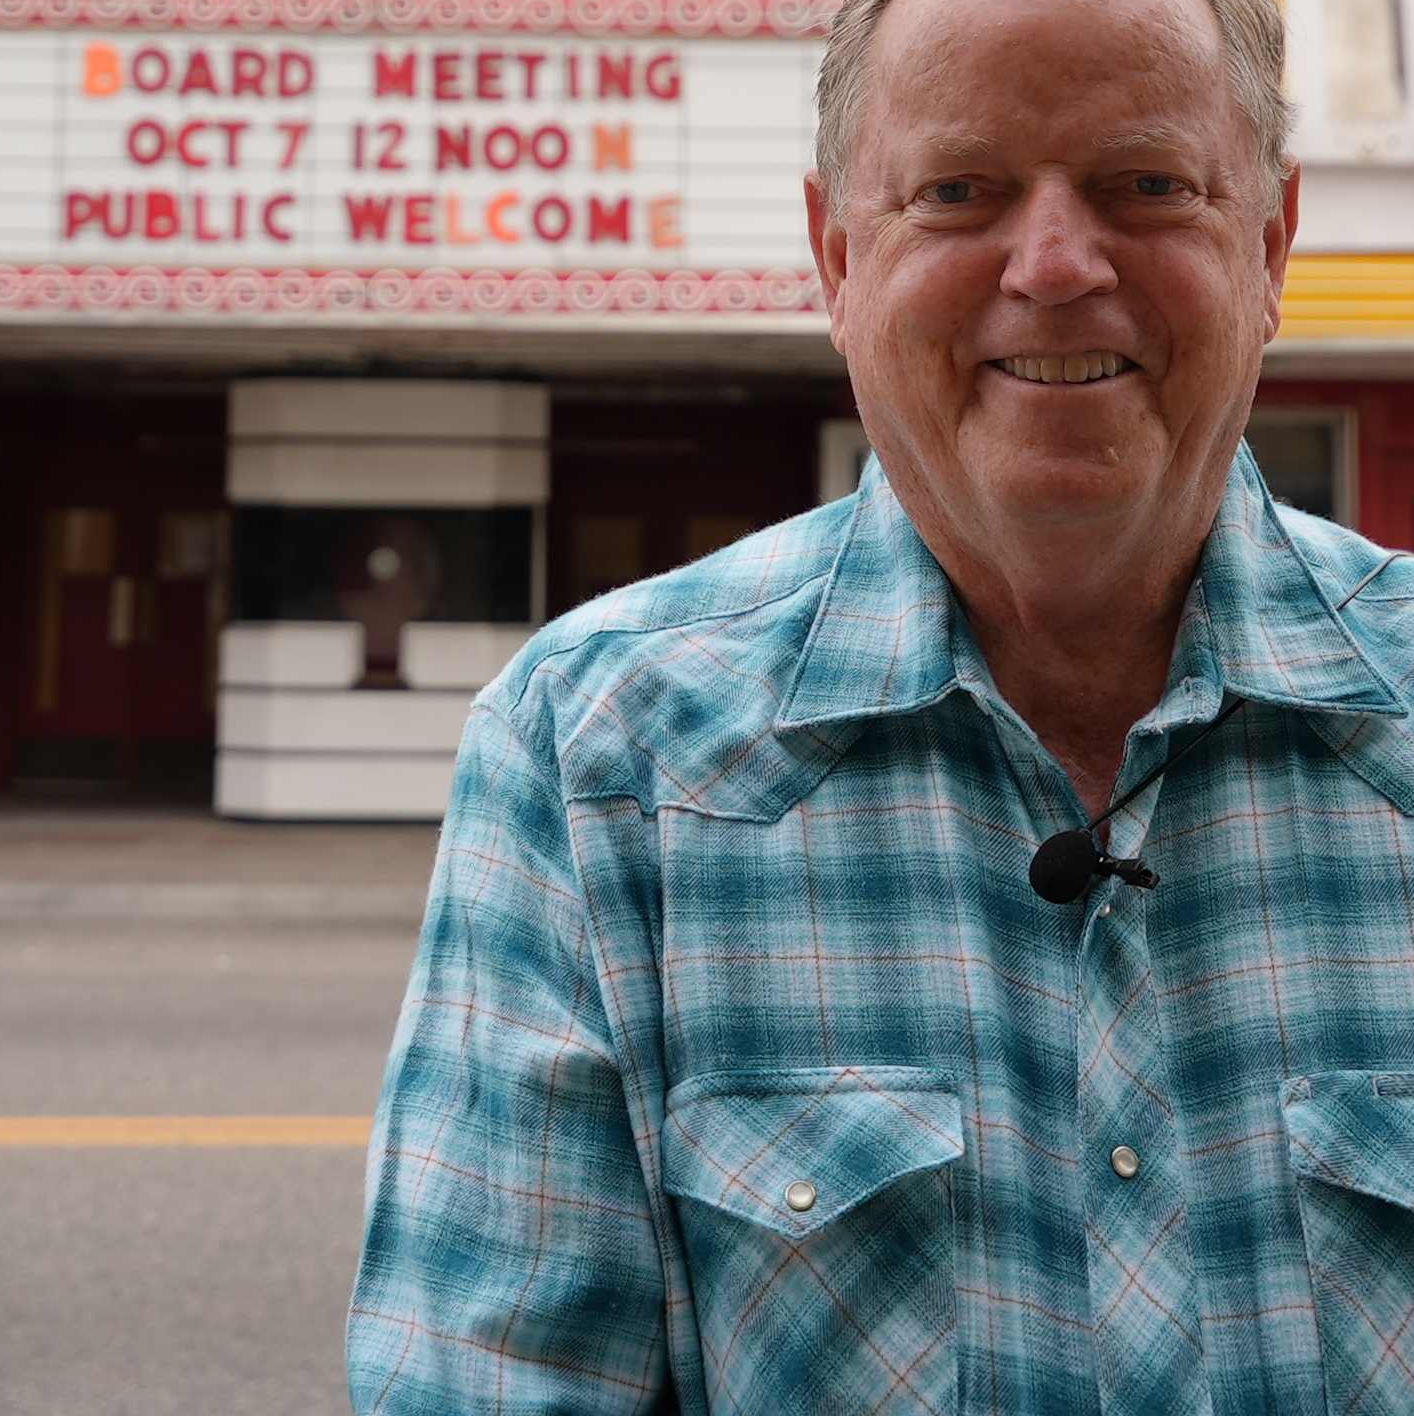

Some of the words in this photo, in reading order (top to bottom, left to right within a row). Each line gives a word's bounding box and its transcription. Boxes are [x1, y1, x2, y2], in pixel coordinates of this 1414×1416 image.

[82, 45, 314, 98] BOARD
[373, 50, 681, 100] MEETING
[127, 120, 248, 167] OCT
[277, 121, 308, 168] 7
[353, 122, 407, 170] 12
[435, 124, 631, 171] NOON
[65, 192, 294, 240] PUBLIC
[344, 191, 685, 249] WELCOME
